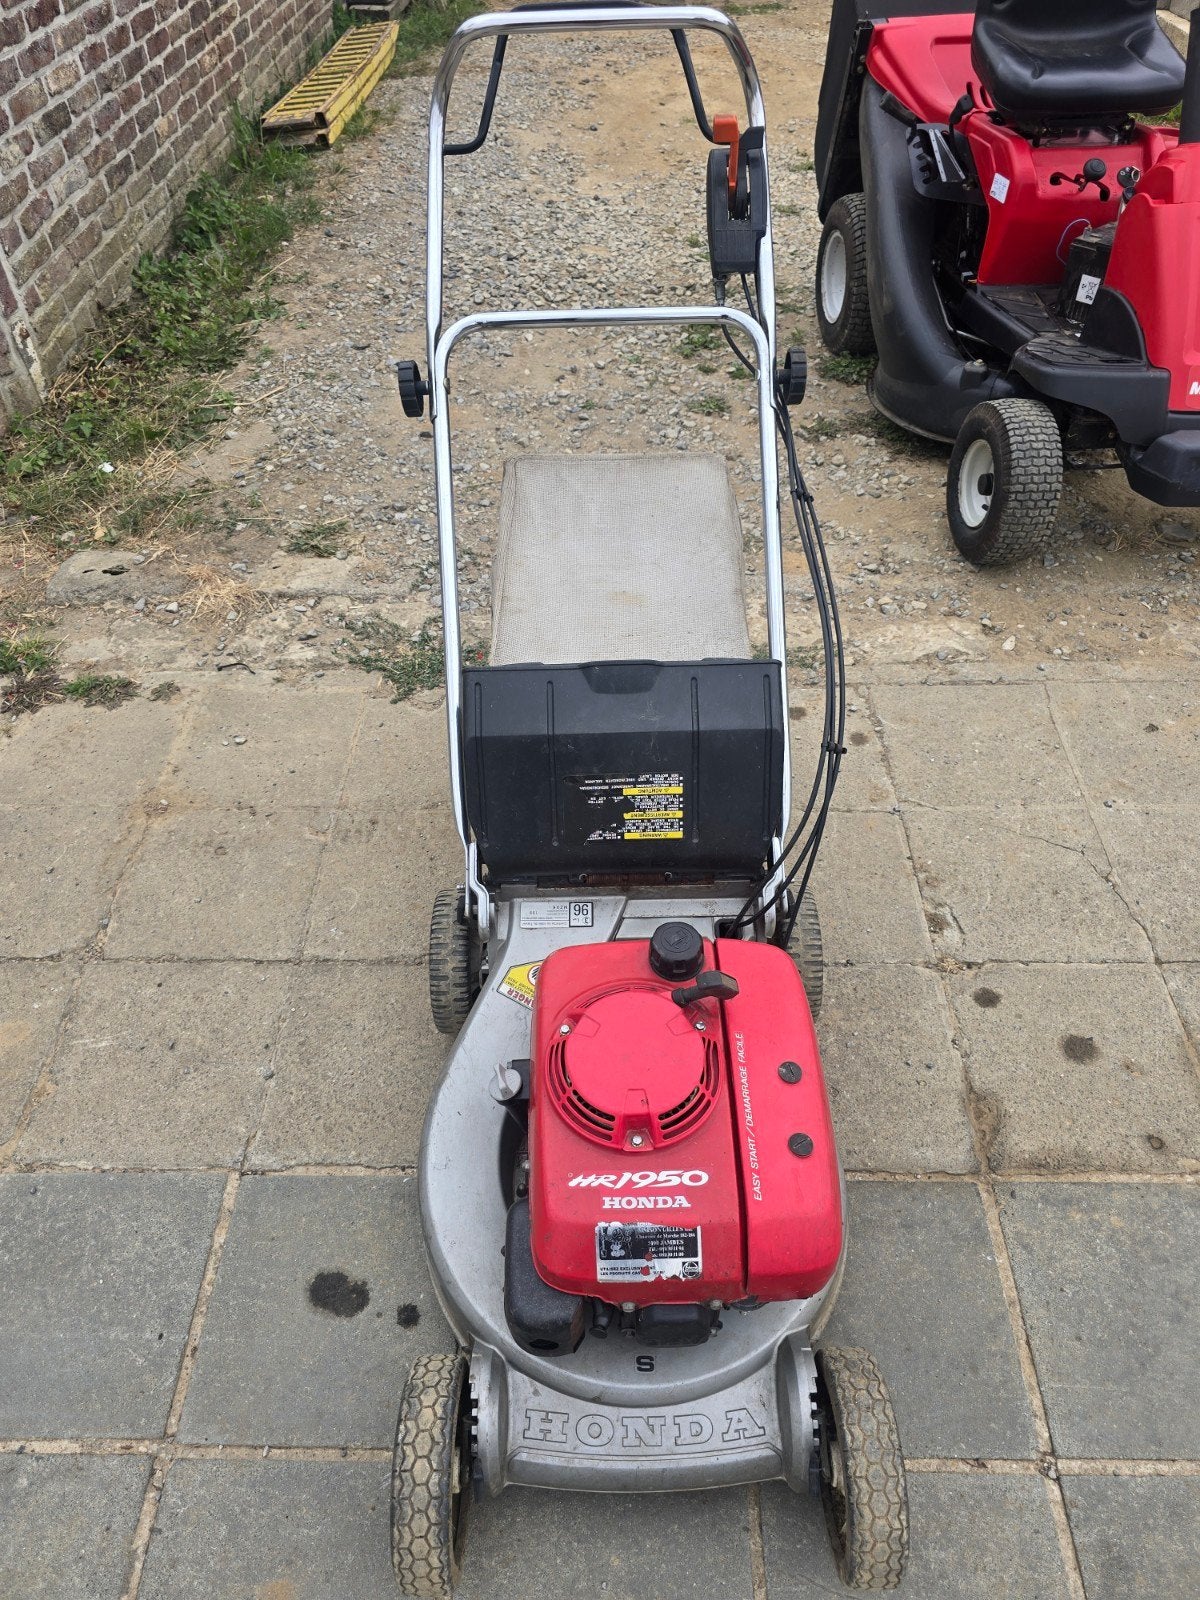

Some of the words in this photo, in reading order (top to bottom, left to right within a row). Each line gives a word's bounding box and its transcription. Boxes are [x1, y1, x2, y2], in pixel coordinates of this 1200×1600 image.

[573, 903, 589, 916] 96
[507, 987, 535, 1008] NGER
[735, 1033, 746, 1063] FACILE
[568, 1170, 709, 1189] HR1950
[753, 1174, 762, 1200] EASY
[602, 1196, 691, 1209] HONDA
[636, 1355, 655, 1372] S
[523, 1407, 766, 1447] HONDA
